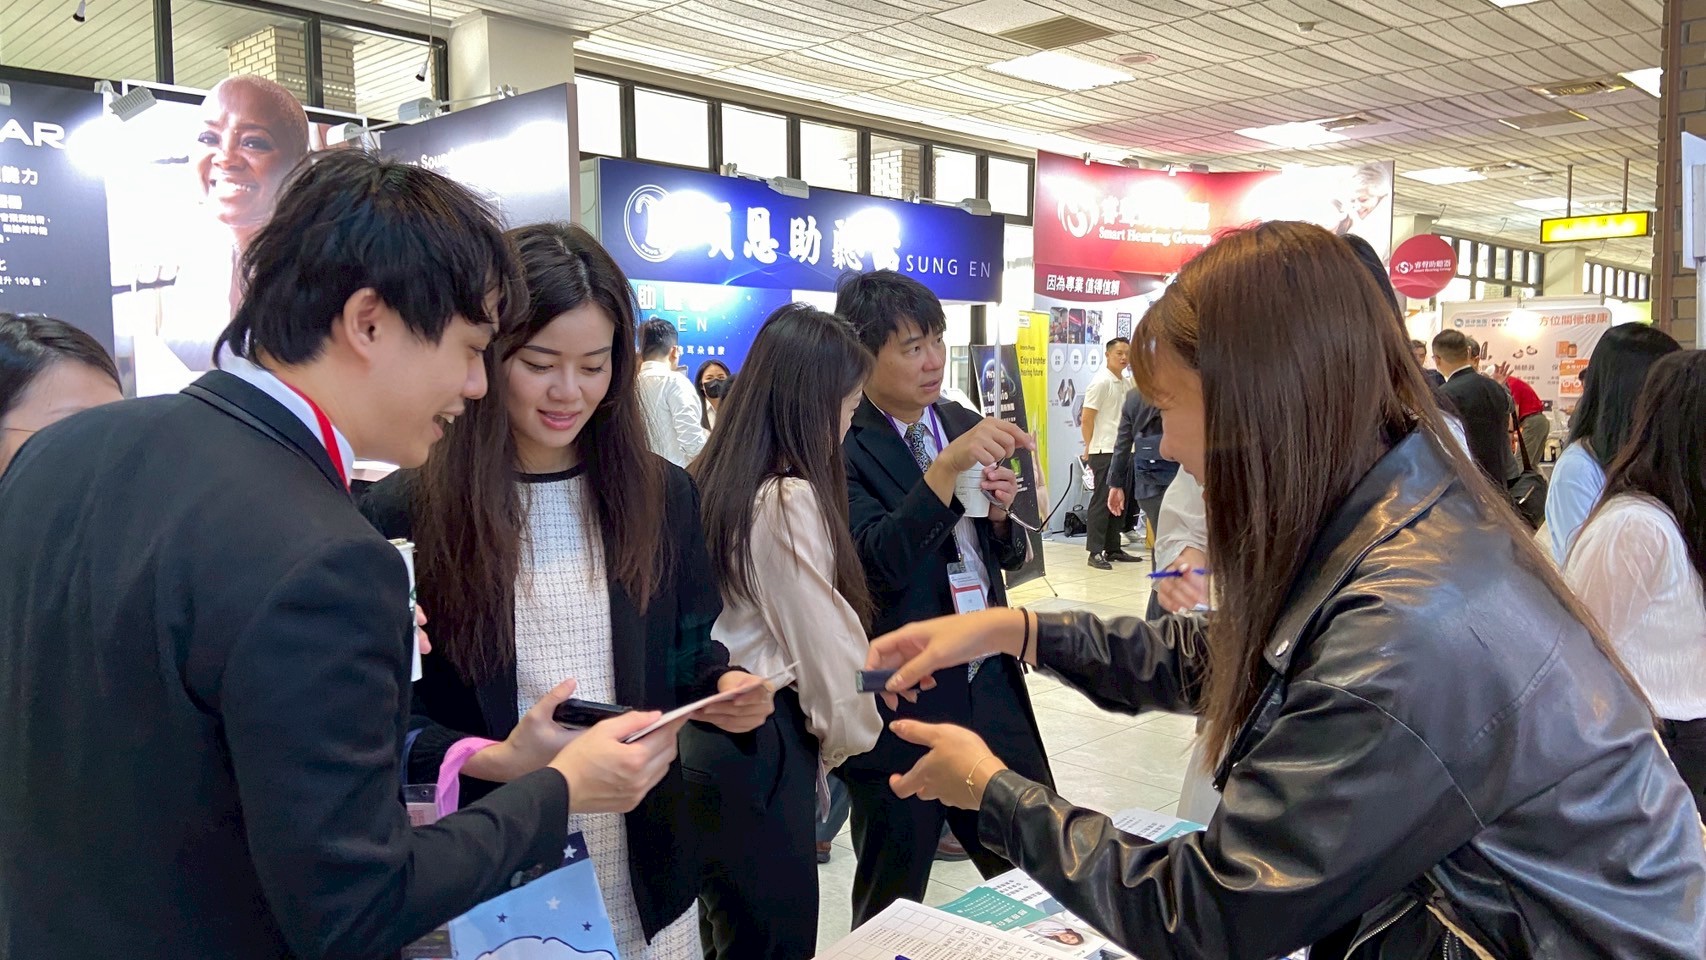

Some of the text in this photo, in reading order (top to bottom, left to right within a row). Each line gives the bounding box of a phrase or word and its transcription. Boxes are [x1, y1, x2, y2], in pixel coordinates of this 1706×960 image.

[0, 119, 65, 149] AR
[1099, 226, 1212, 248] Smart Hearing Group
[906, 255, 991, 278] SUNG EN
[15, 277, 30, 286] 100
[1046, 274, 1084, 293] 因為專業
